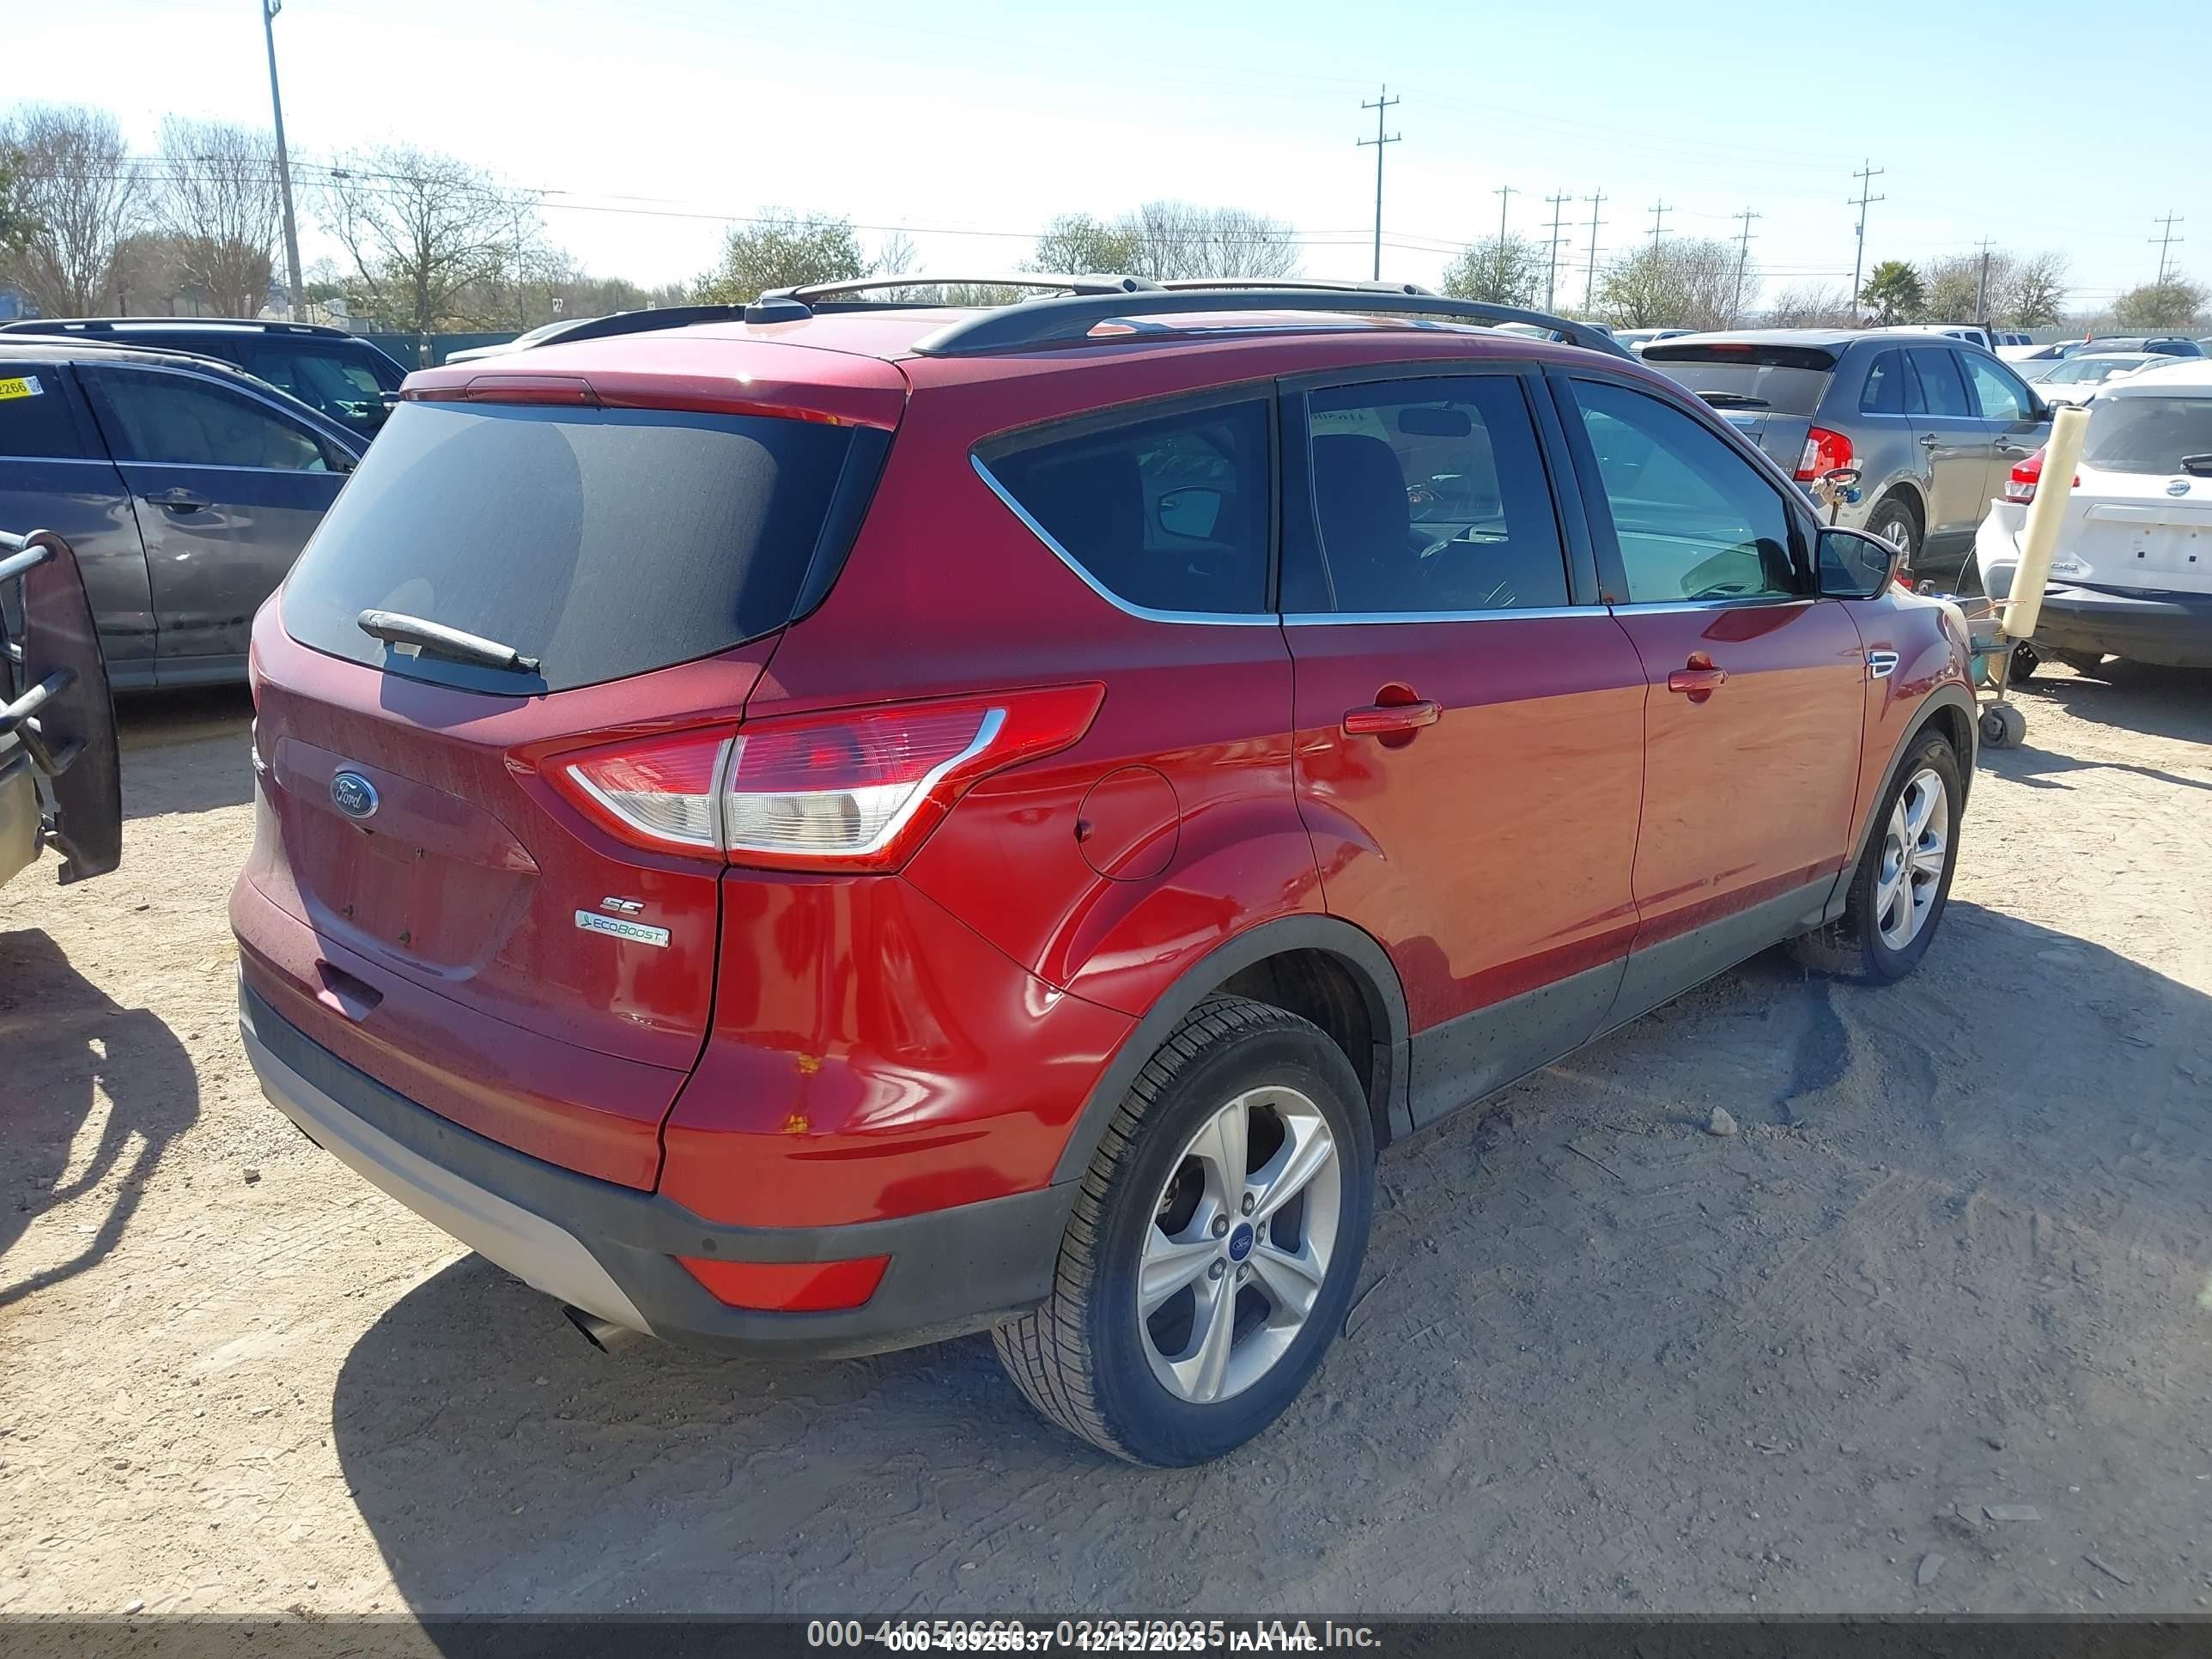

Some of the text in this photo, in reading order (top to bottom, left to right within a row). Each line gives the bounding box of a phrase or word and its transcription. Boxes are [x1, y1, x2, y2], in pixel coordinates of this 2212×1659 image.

[336, 780, 363, 809] Ford
[599, 896, 645, 915] SE
[592, 918, 664, 941] ECOBOOST
